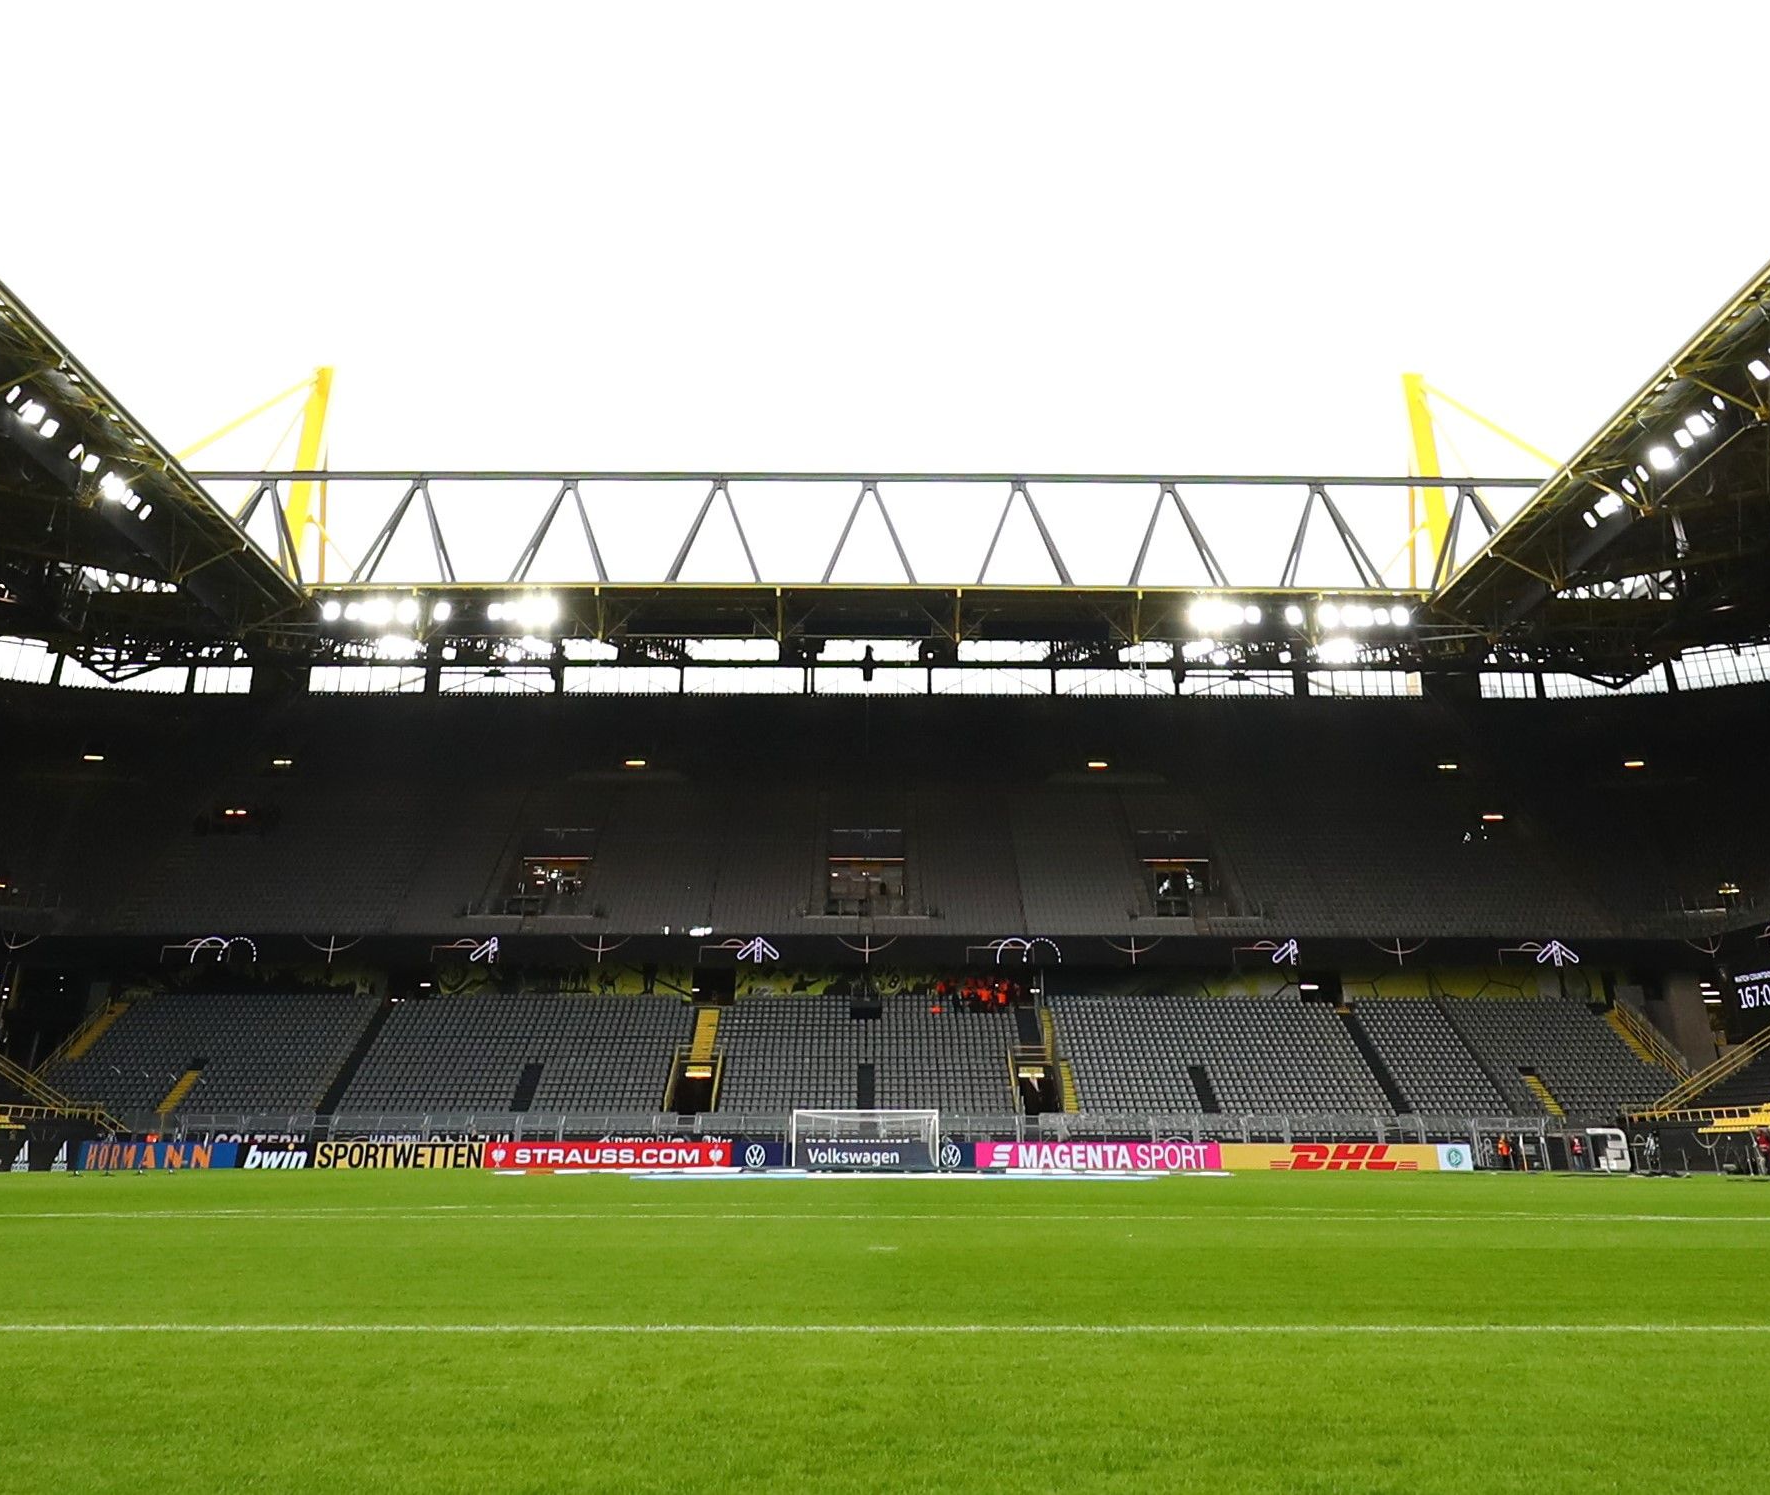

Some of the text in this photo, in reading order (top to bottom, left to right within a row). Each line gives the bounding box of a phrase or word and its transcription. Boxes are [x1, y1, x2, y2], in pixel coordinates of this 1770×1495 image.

[243, 1143, 483, 1169] bwin SPORTWETTEN
[515, 1148, 699, 1165] STRAUSS.COM
[807, 1147, 900, 1167] Volkswagen
[1018, 1144, 1208, 1169] MAGENTA SPORT
[1290, 1144, 1398, 1170] DHL
